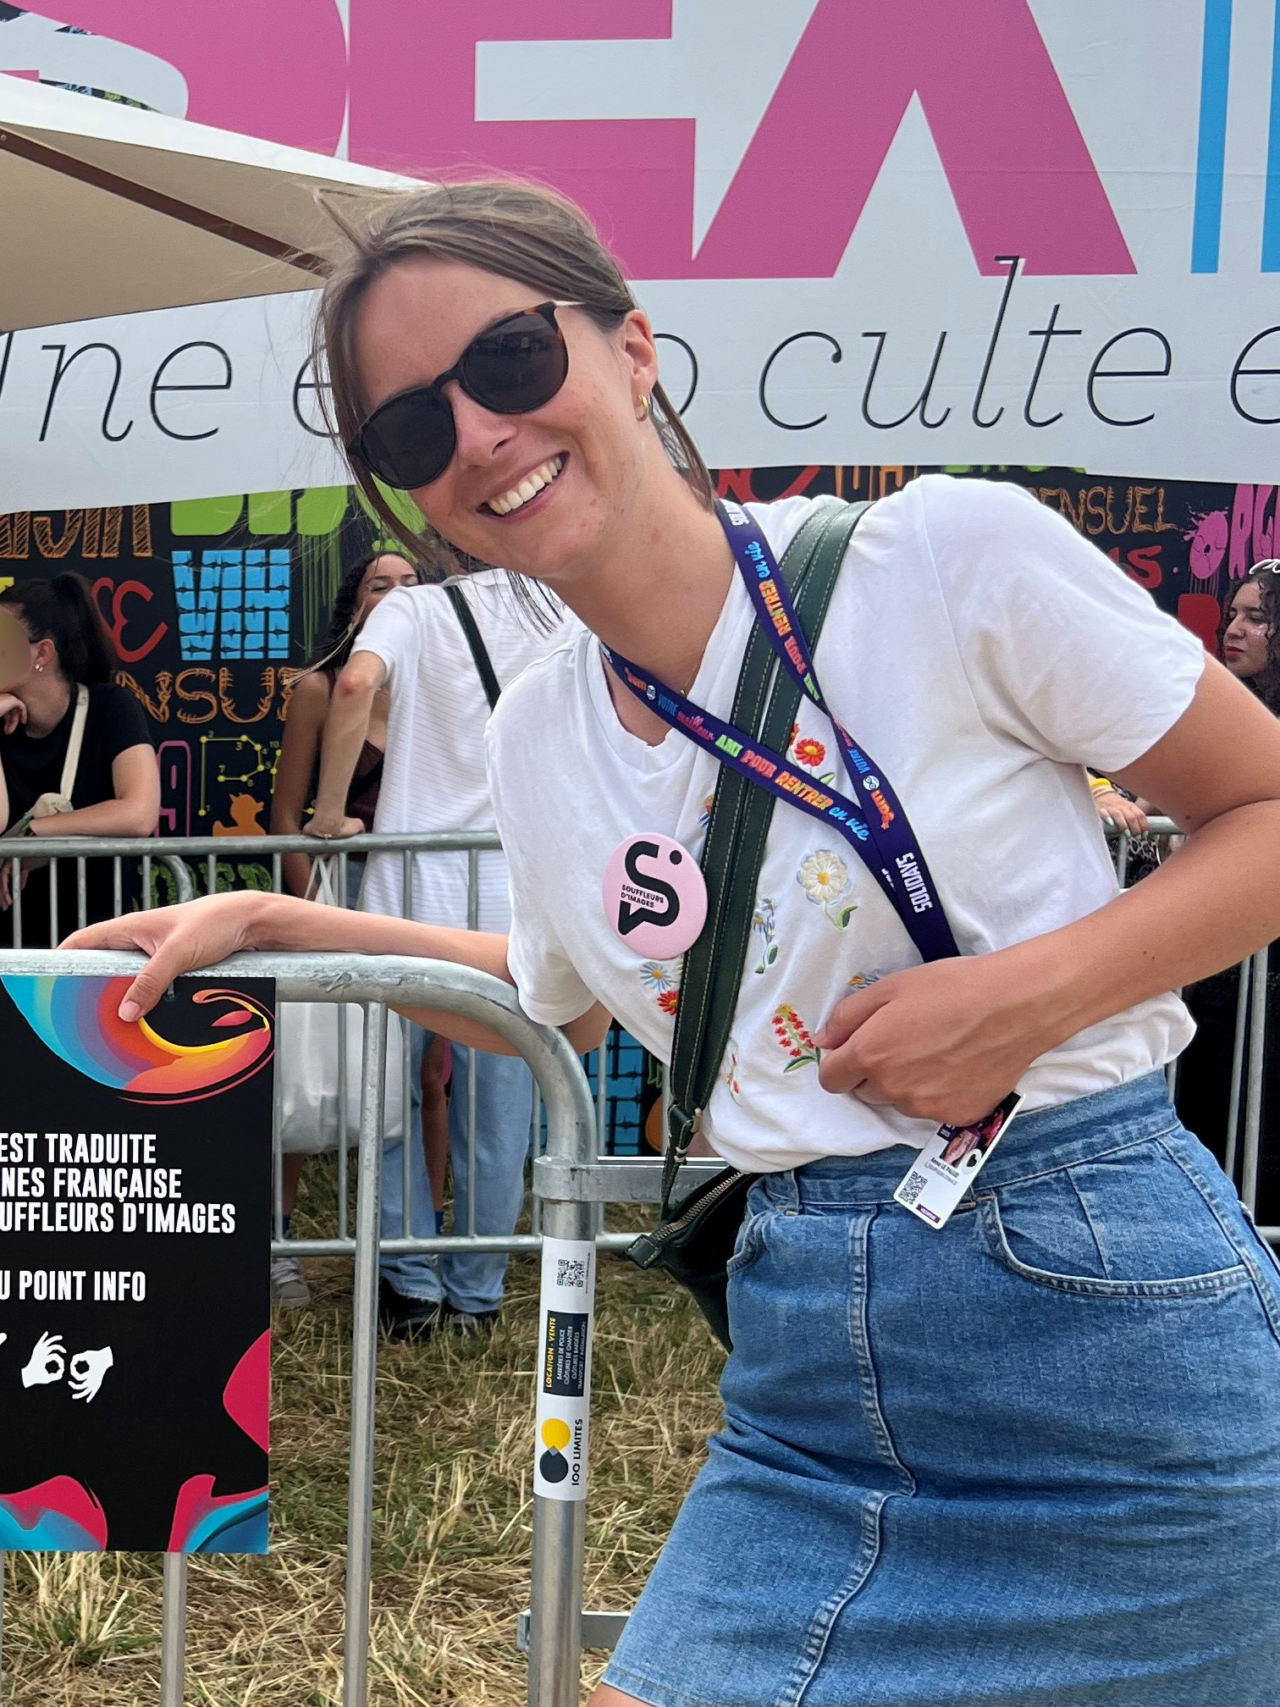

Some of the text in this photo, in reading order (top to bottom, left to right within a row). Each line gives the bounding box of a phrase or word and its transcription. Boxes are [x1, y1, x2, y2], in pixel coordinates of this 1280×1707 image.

[757, 255, 1173, 431] culte
[171, 549, 290, 661] VIH
[758, 578, 793, 637] RENTRER
[715, 734, 744, 758] AMI
[740, 749, 778, 778] POUR
[773, 770, 834, 811] RENTRER
[828, 806, 848, 821] en
[845, 818, 870, 841] vie
[620, 891, 655, 908] D'IMAGES
[621, 884, 664, 904] SOUFFLEURS
[895, 852, 933, 913] SOLIDAYS
[45, 1134, 156, 1164] TRADUITE
[53, 1169, 182, 1202] FRANÇAISE
[123, 1203, 236, 1233] D'IMAGES
[19, 1270, 86, 1301] POINT
[94, 1271, 146, 1301] INFO
[548, 1317, 556, 1342] VENTE
[546, 1347, 554, 1388] LOCATION
[572, 1418, 583, 1459] LIMITES
